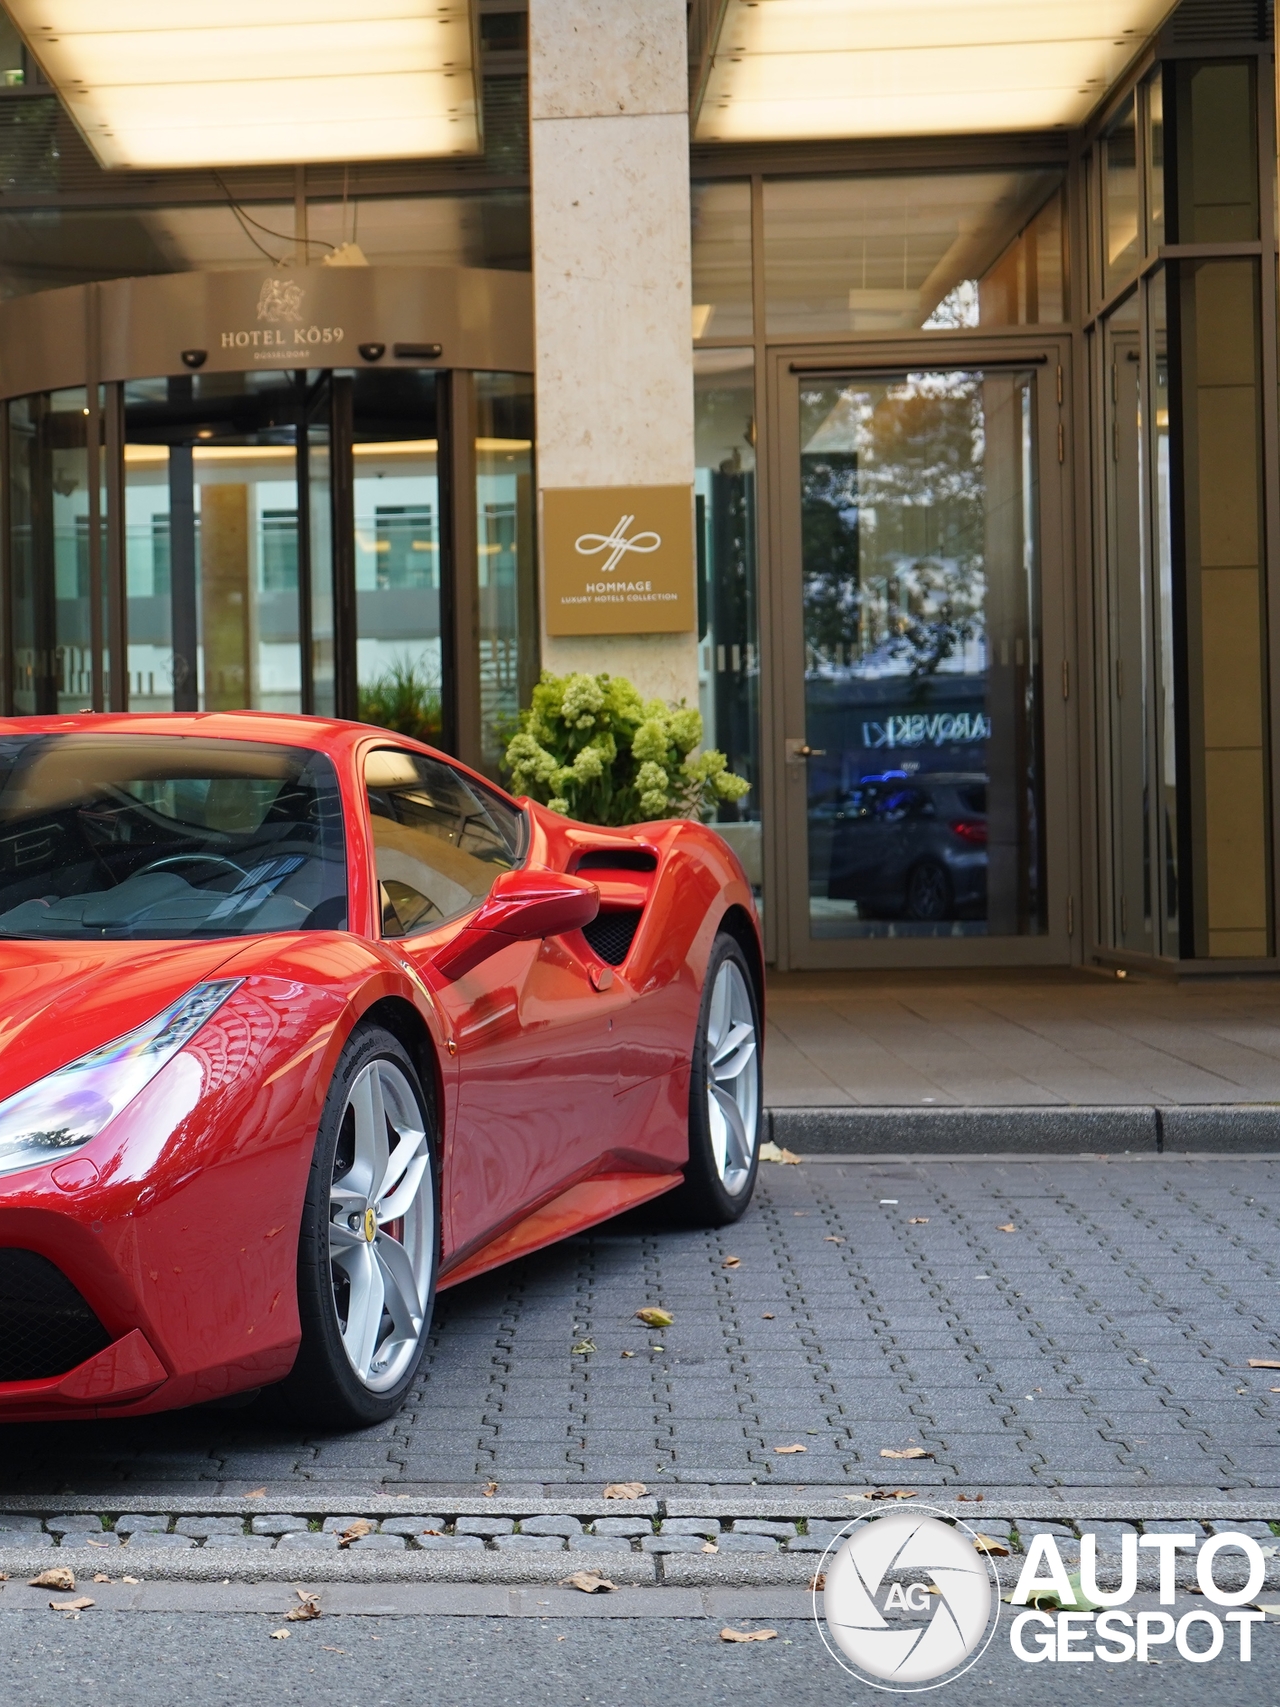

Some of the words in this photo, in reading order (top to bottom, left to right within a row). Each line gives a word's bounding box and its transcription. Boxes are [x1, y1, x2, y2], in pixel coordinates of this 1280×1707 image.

[221, 329, 286, 348] HOTEL
[294, 325, 344, 345] KÖ59
[253, 350, 311, 360] DÜSSELDORF
[586, 581, 652, 593] HOMMAGE
[561, 596, 592, 604] LUXURY
[594, 595, 624, 603] HOTELS
[627, 593, 678, 603] COLLECTION
